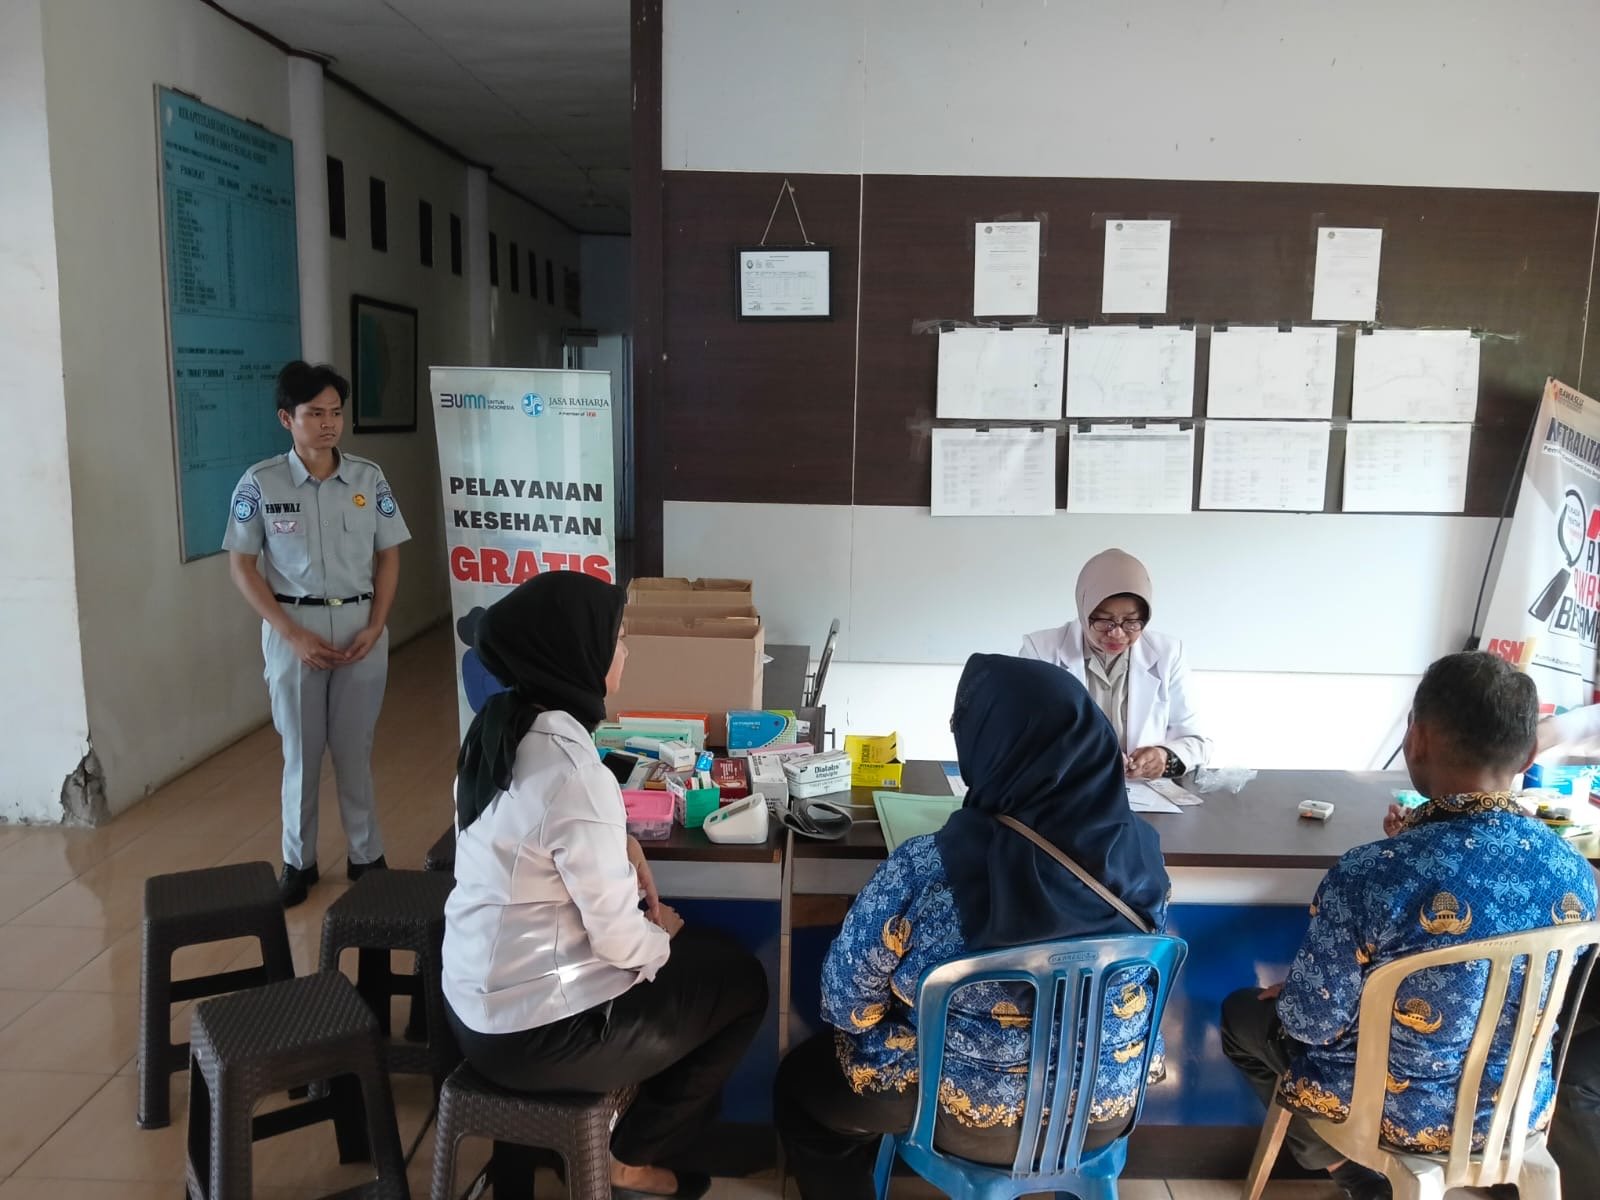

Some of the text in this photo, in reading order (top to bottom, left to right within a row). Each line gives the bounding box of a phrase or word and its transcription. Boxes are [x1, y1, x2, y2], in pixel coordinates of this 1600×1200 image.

[549, 397, 609, 408] JASA RAHARJA
[450, 476, 603, 502] PELAYANAN
[453, 509, 602, 536] KESEHATAN
[450, 546, 612, 586] GRATIS
